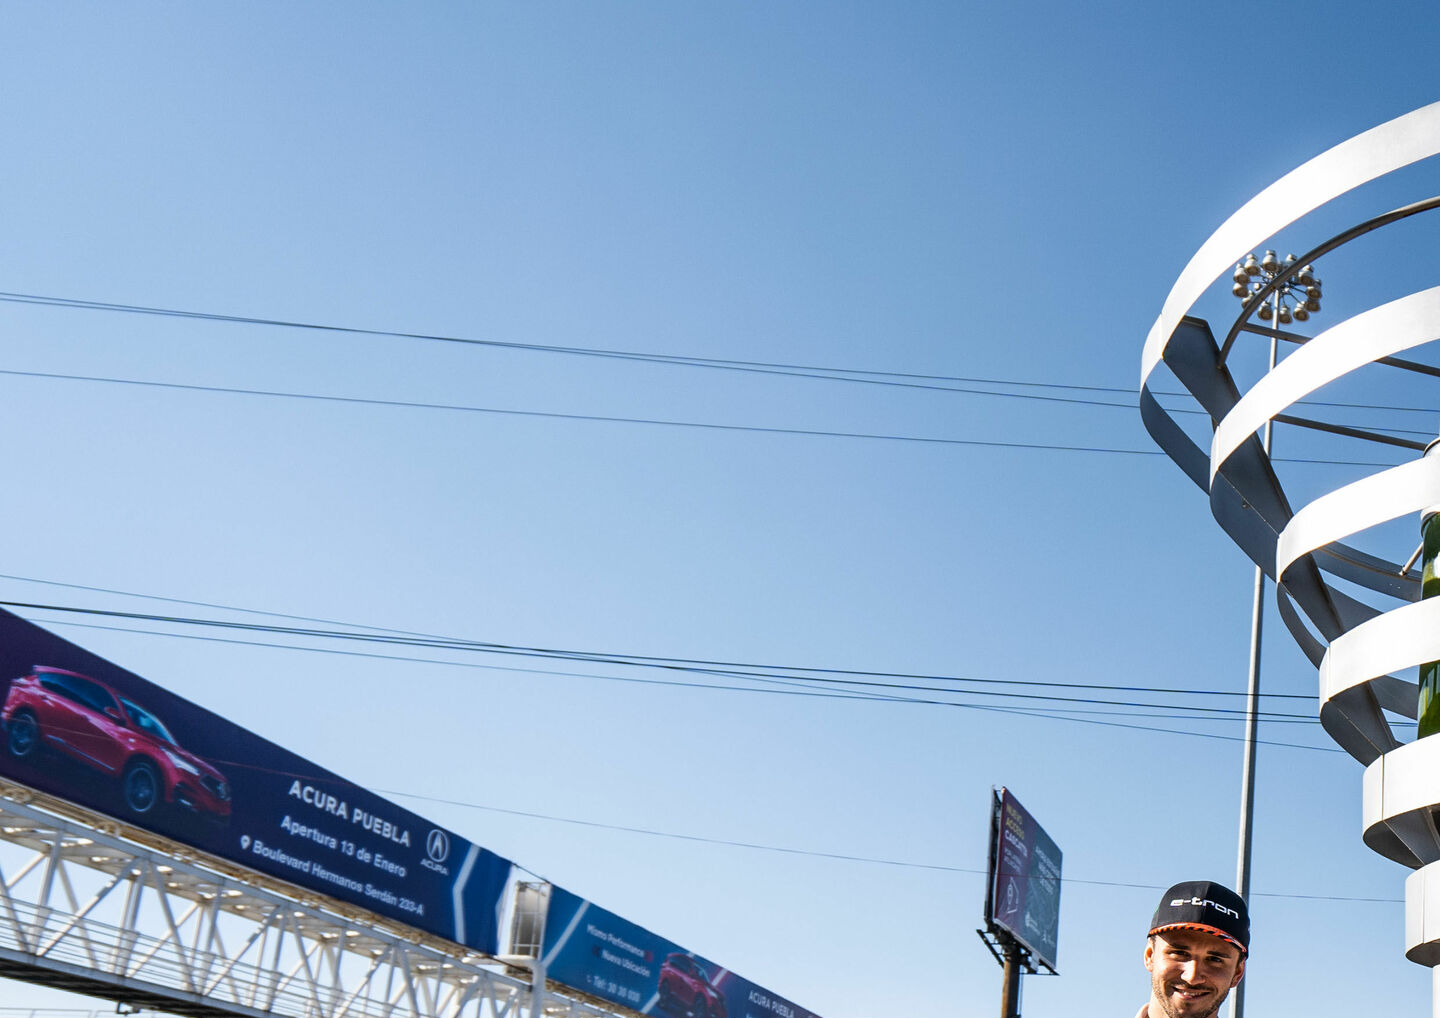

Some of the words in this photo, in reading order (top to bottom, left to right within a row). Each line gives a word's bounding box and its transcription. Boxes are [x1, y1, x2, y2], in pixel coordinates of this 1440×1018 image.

[288, 779, 349, 820] ACURA
[352, 808, 411, 848] PUEBLA
[252, 839, 310, 873] Boulevard
[312, 863, 363, 892] Hermanos
[281, 815, 338, 849] Apertura
[341, 840, 354, 856] 13
[356, 847, 371, 863] de
[374, 855, 407, 878] Enero
[420, 858, 449, 876] ACURA
[1170, 896, 1239, 919] e-tron
[748, 989, 771, 1010] ACURA
